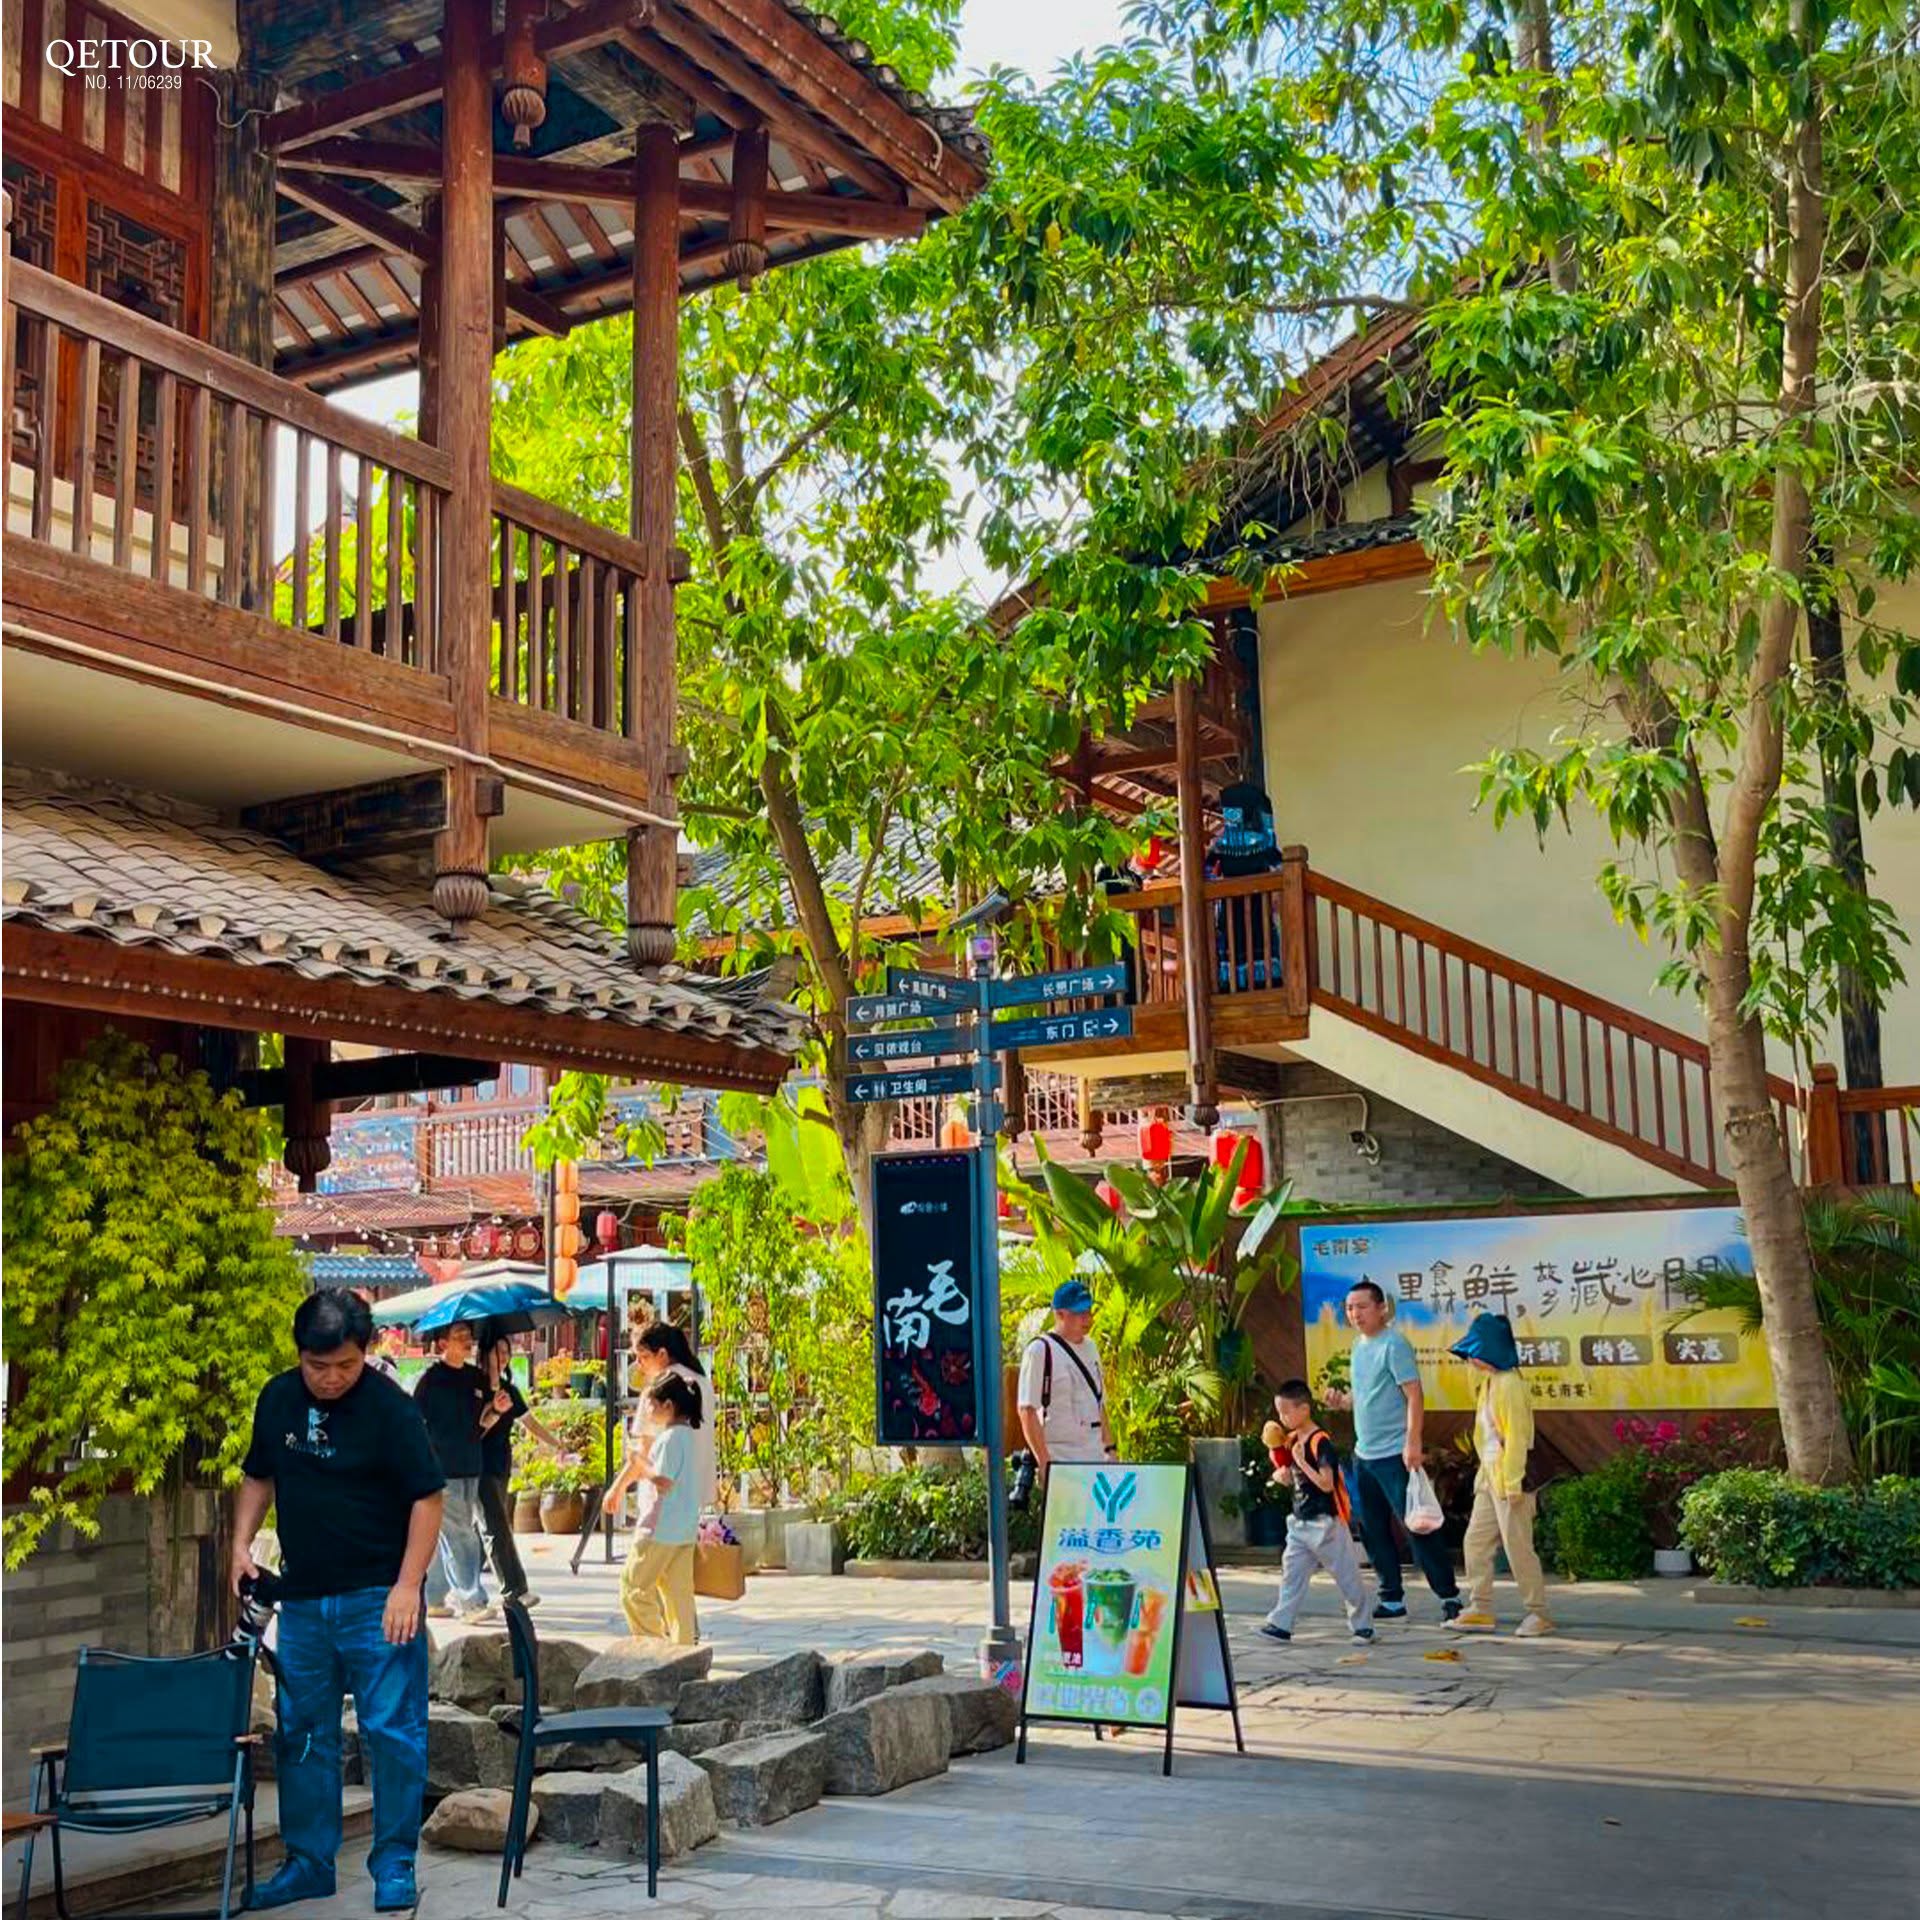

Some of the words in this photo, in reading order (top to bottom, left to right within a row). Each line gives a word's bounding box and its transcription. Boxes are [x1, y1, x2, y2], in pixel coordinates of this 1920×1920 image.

[890, 1079, 927, 1095] 卫生间
[1592, 1338, 1640, 1363] 特色
